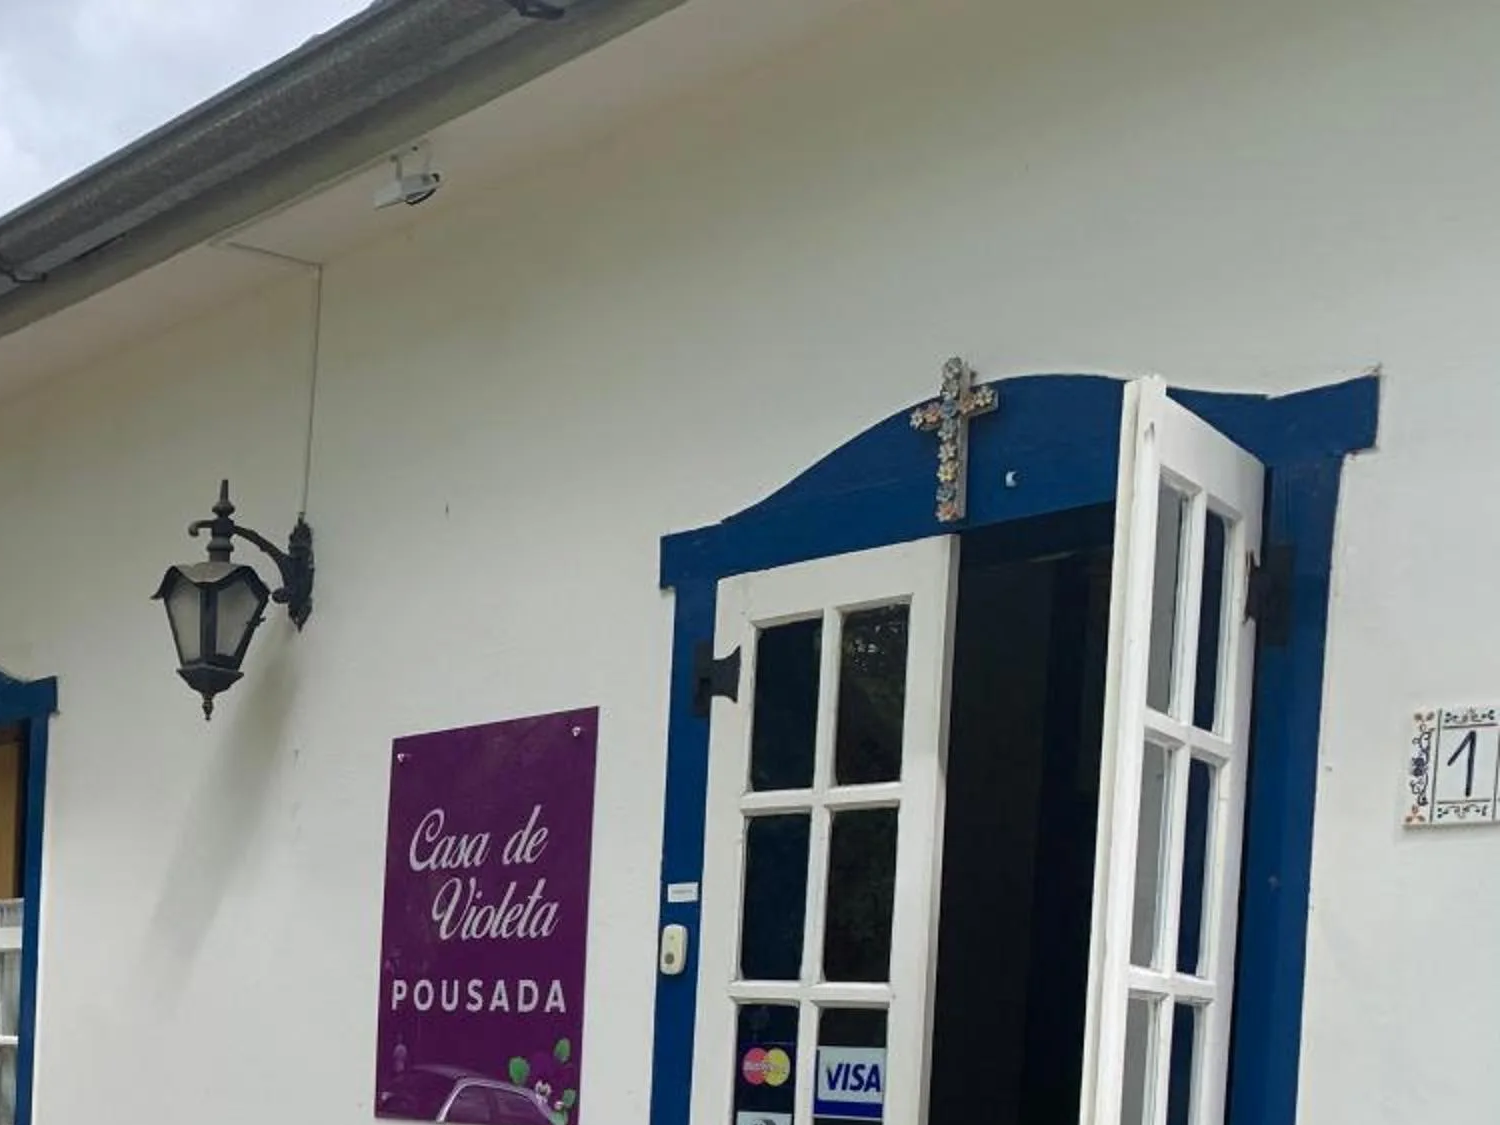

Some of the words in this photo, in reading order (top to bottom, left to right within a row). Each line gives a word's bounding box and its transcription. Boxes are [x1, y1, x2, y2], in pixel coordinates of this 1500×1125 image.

[1446, 730, 1477, 797] 1
[409, 808, 491, 871] Casa
[502, 804, 548, 865] de
[431, 877, 560, 941] Violeta
[390, 979, 567, 1013] POUSADA
[825, 1062, 881, 1092] VISA
